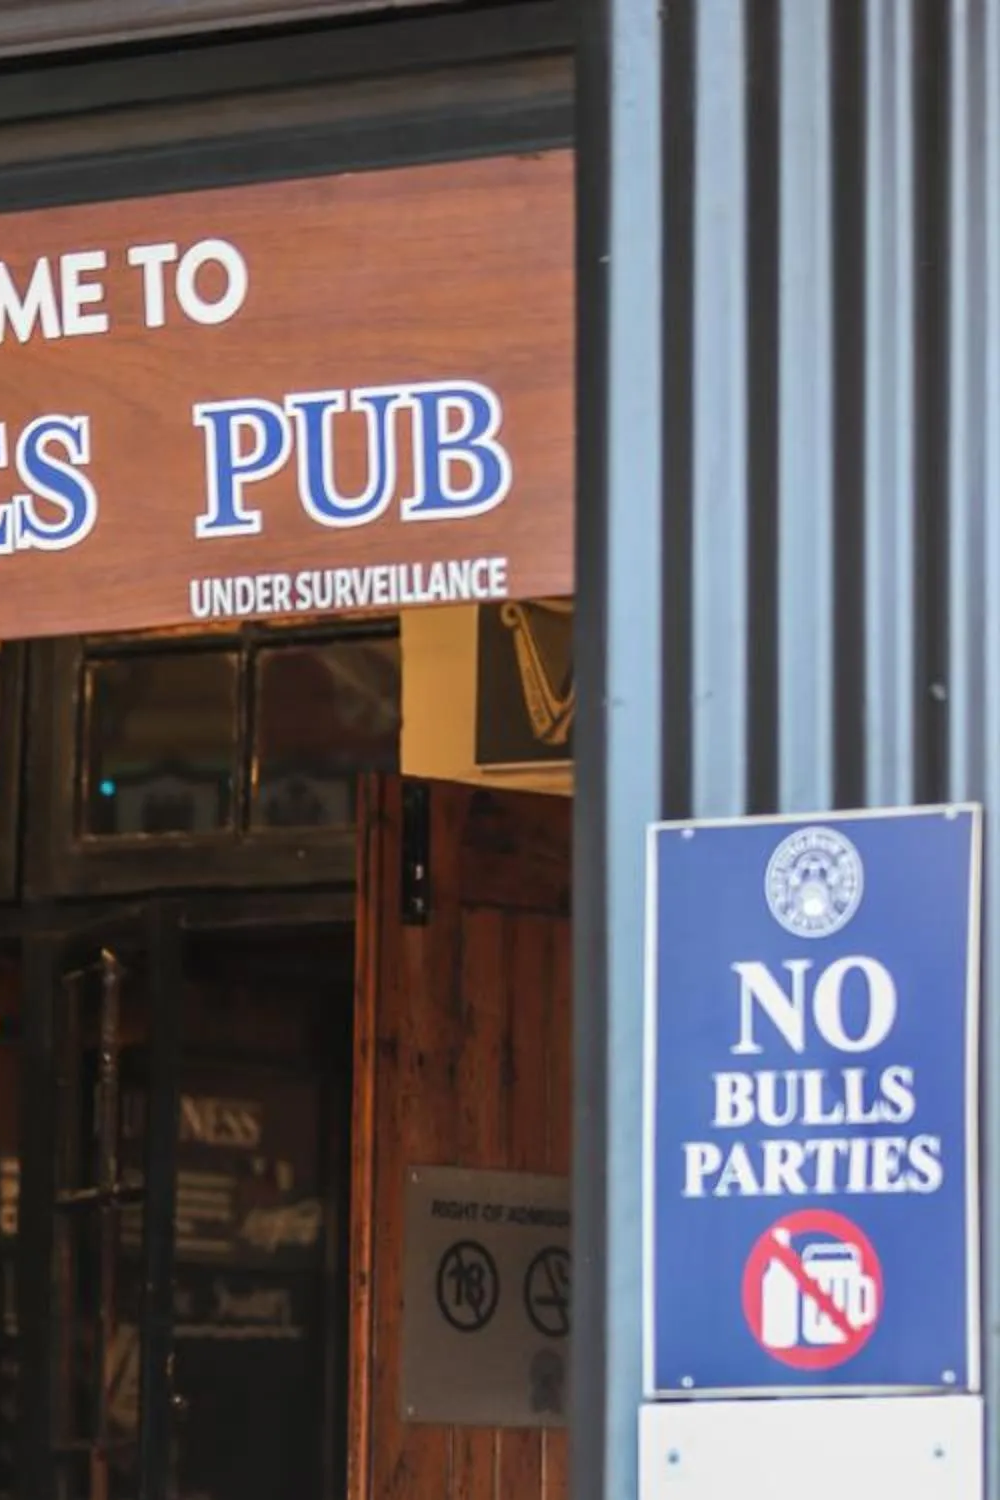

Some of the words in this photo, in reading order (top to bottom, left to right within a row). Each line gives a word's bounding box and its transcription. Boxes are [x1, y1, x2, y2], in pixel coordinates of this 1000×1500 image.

[128, 239, 248, 327] TO
[193, 380, 513, 538] PUB
[190, 575, 292, 617] UNDER
[295, 557, 507, 609] SURVEILLANCE
[730, 955, 898, 1054] NO
[712, 1065, 916, 1128] BULLS
[682, 1134, 943, 1198] PARTIES
